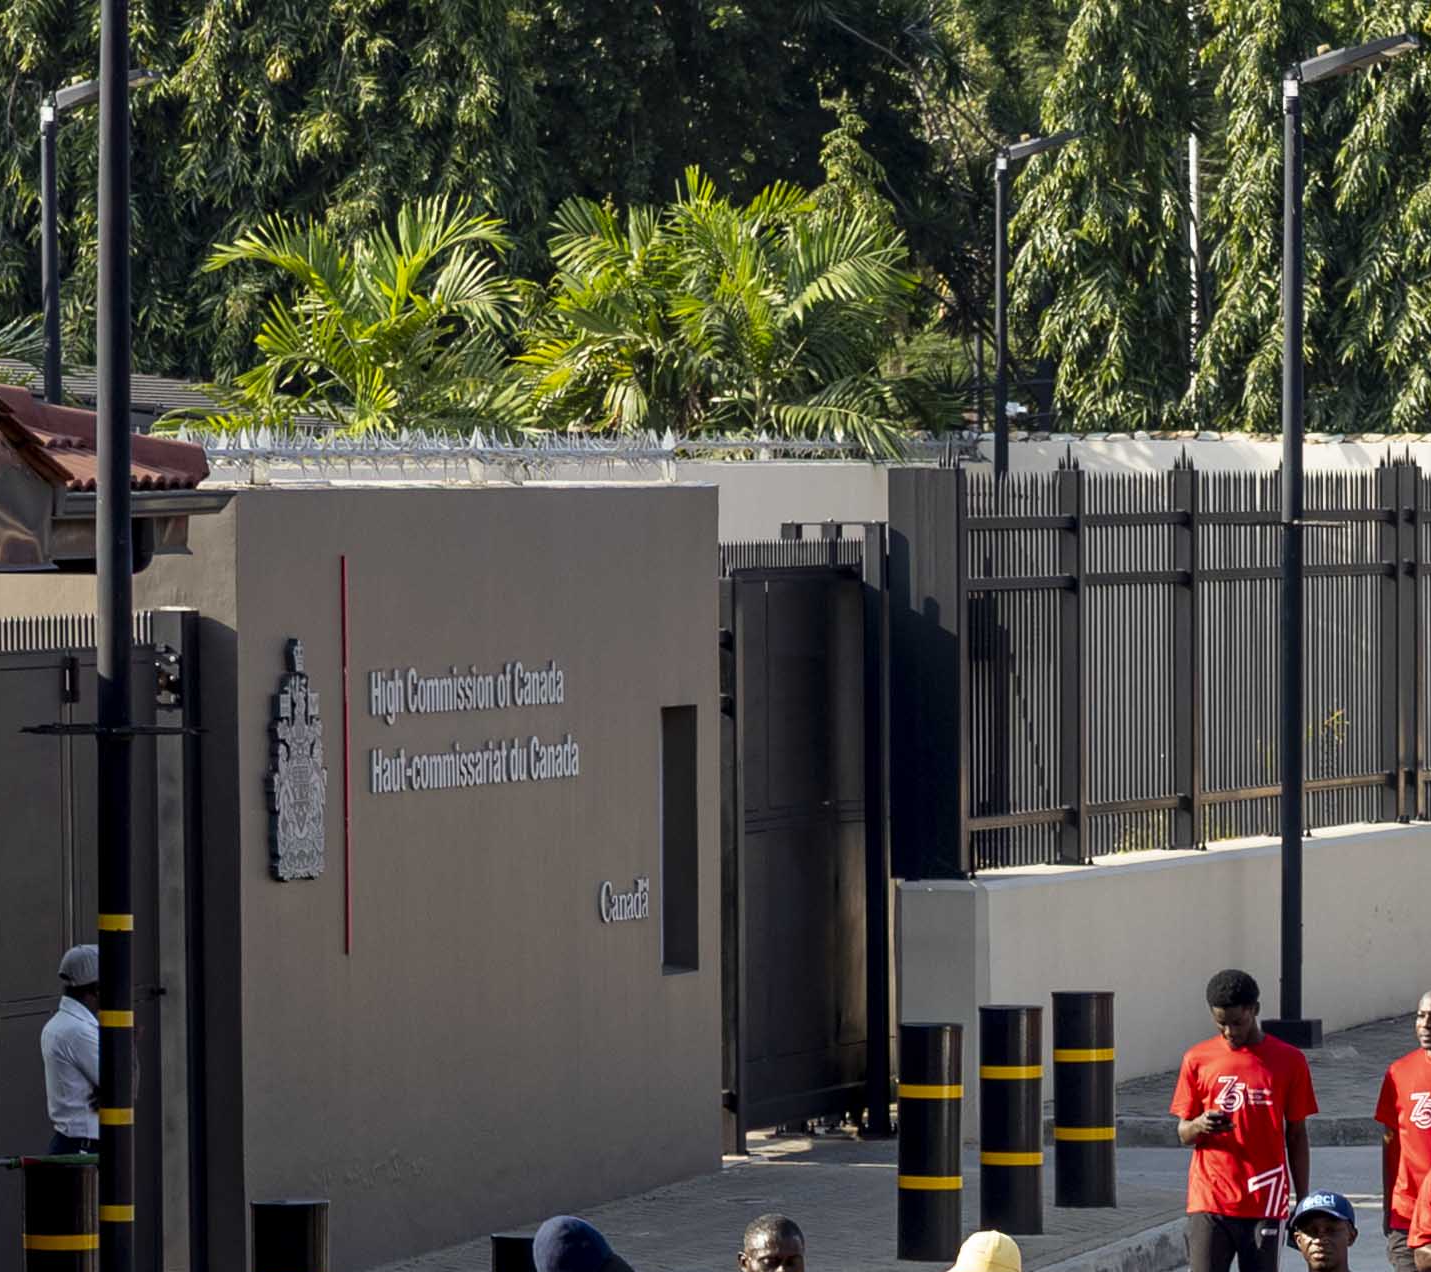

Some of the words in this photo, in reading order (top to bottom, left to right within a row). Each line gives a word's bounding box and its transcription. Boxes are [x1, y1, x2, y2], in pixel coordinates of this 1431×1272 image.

[372, 669, 404, 725] High
[407, 666, 494, 714] Commission
[497, 663, 512, 709] of
[514, 660, 564, 706] Canada
[372, 741, 508, 793] Haut-commissariat
[510, 735, 527, 783] du
[530, 732, 579, 780] Canada
[599, 875, 649, 923] Canada
